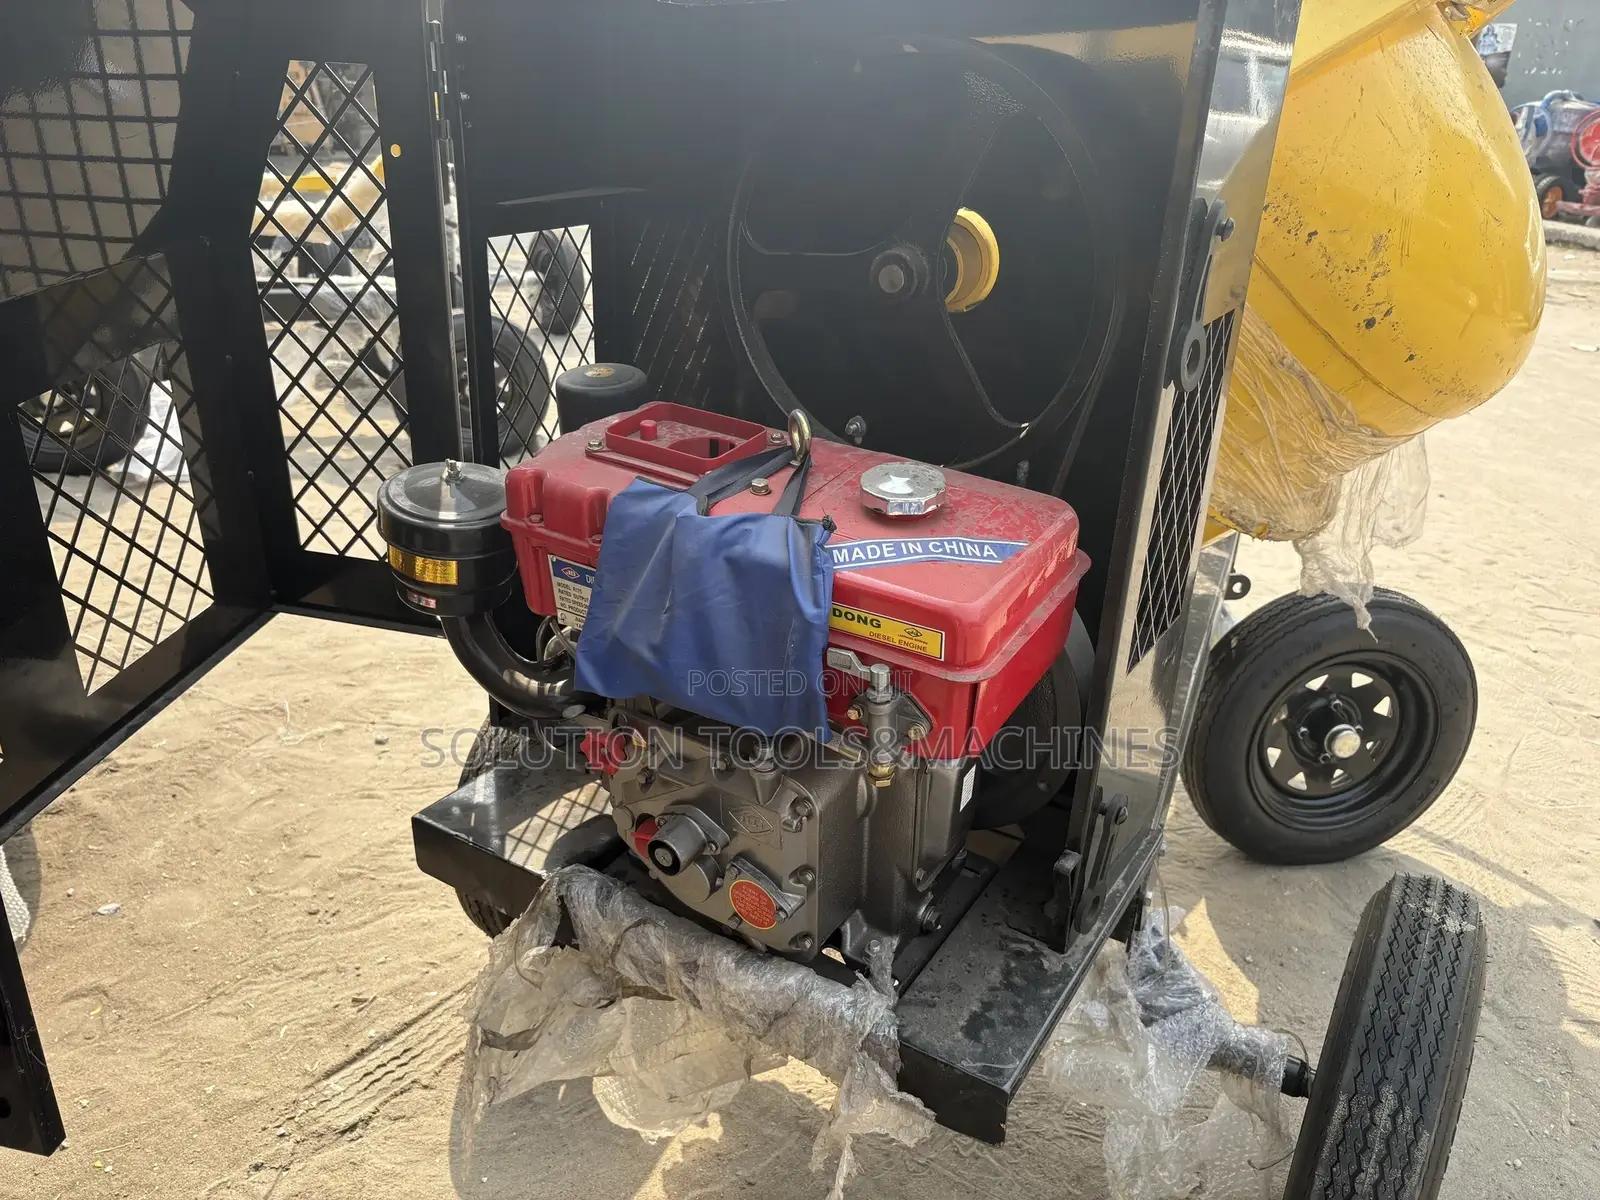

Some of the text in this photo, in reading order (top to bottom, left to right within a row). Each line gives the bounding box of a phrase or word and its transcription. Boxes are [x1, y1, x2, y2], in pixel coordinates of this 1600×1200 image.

[832, 541, 998, 563] MADE IN CHINA
[832, 607, 882, 629] DONG
[869, 631, 897, 644] DIESEL
[898, 639, 928, 652] ENGINE
